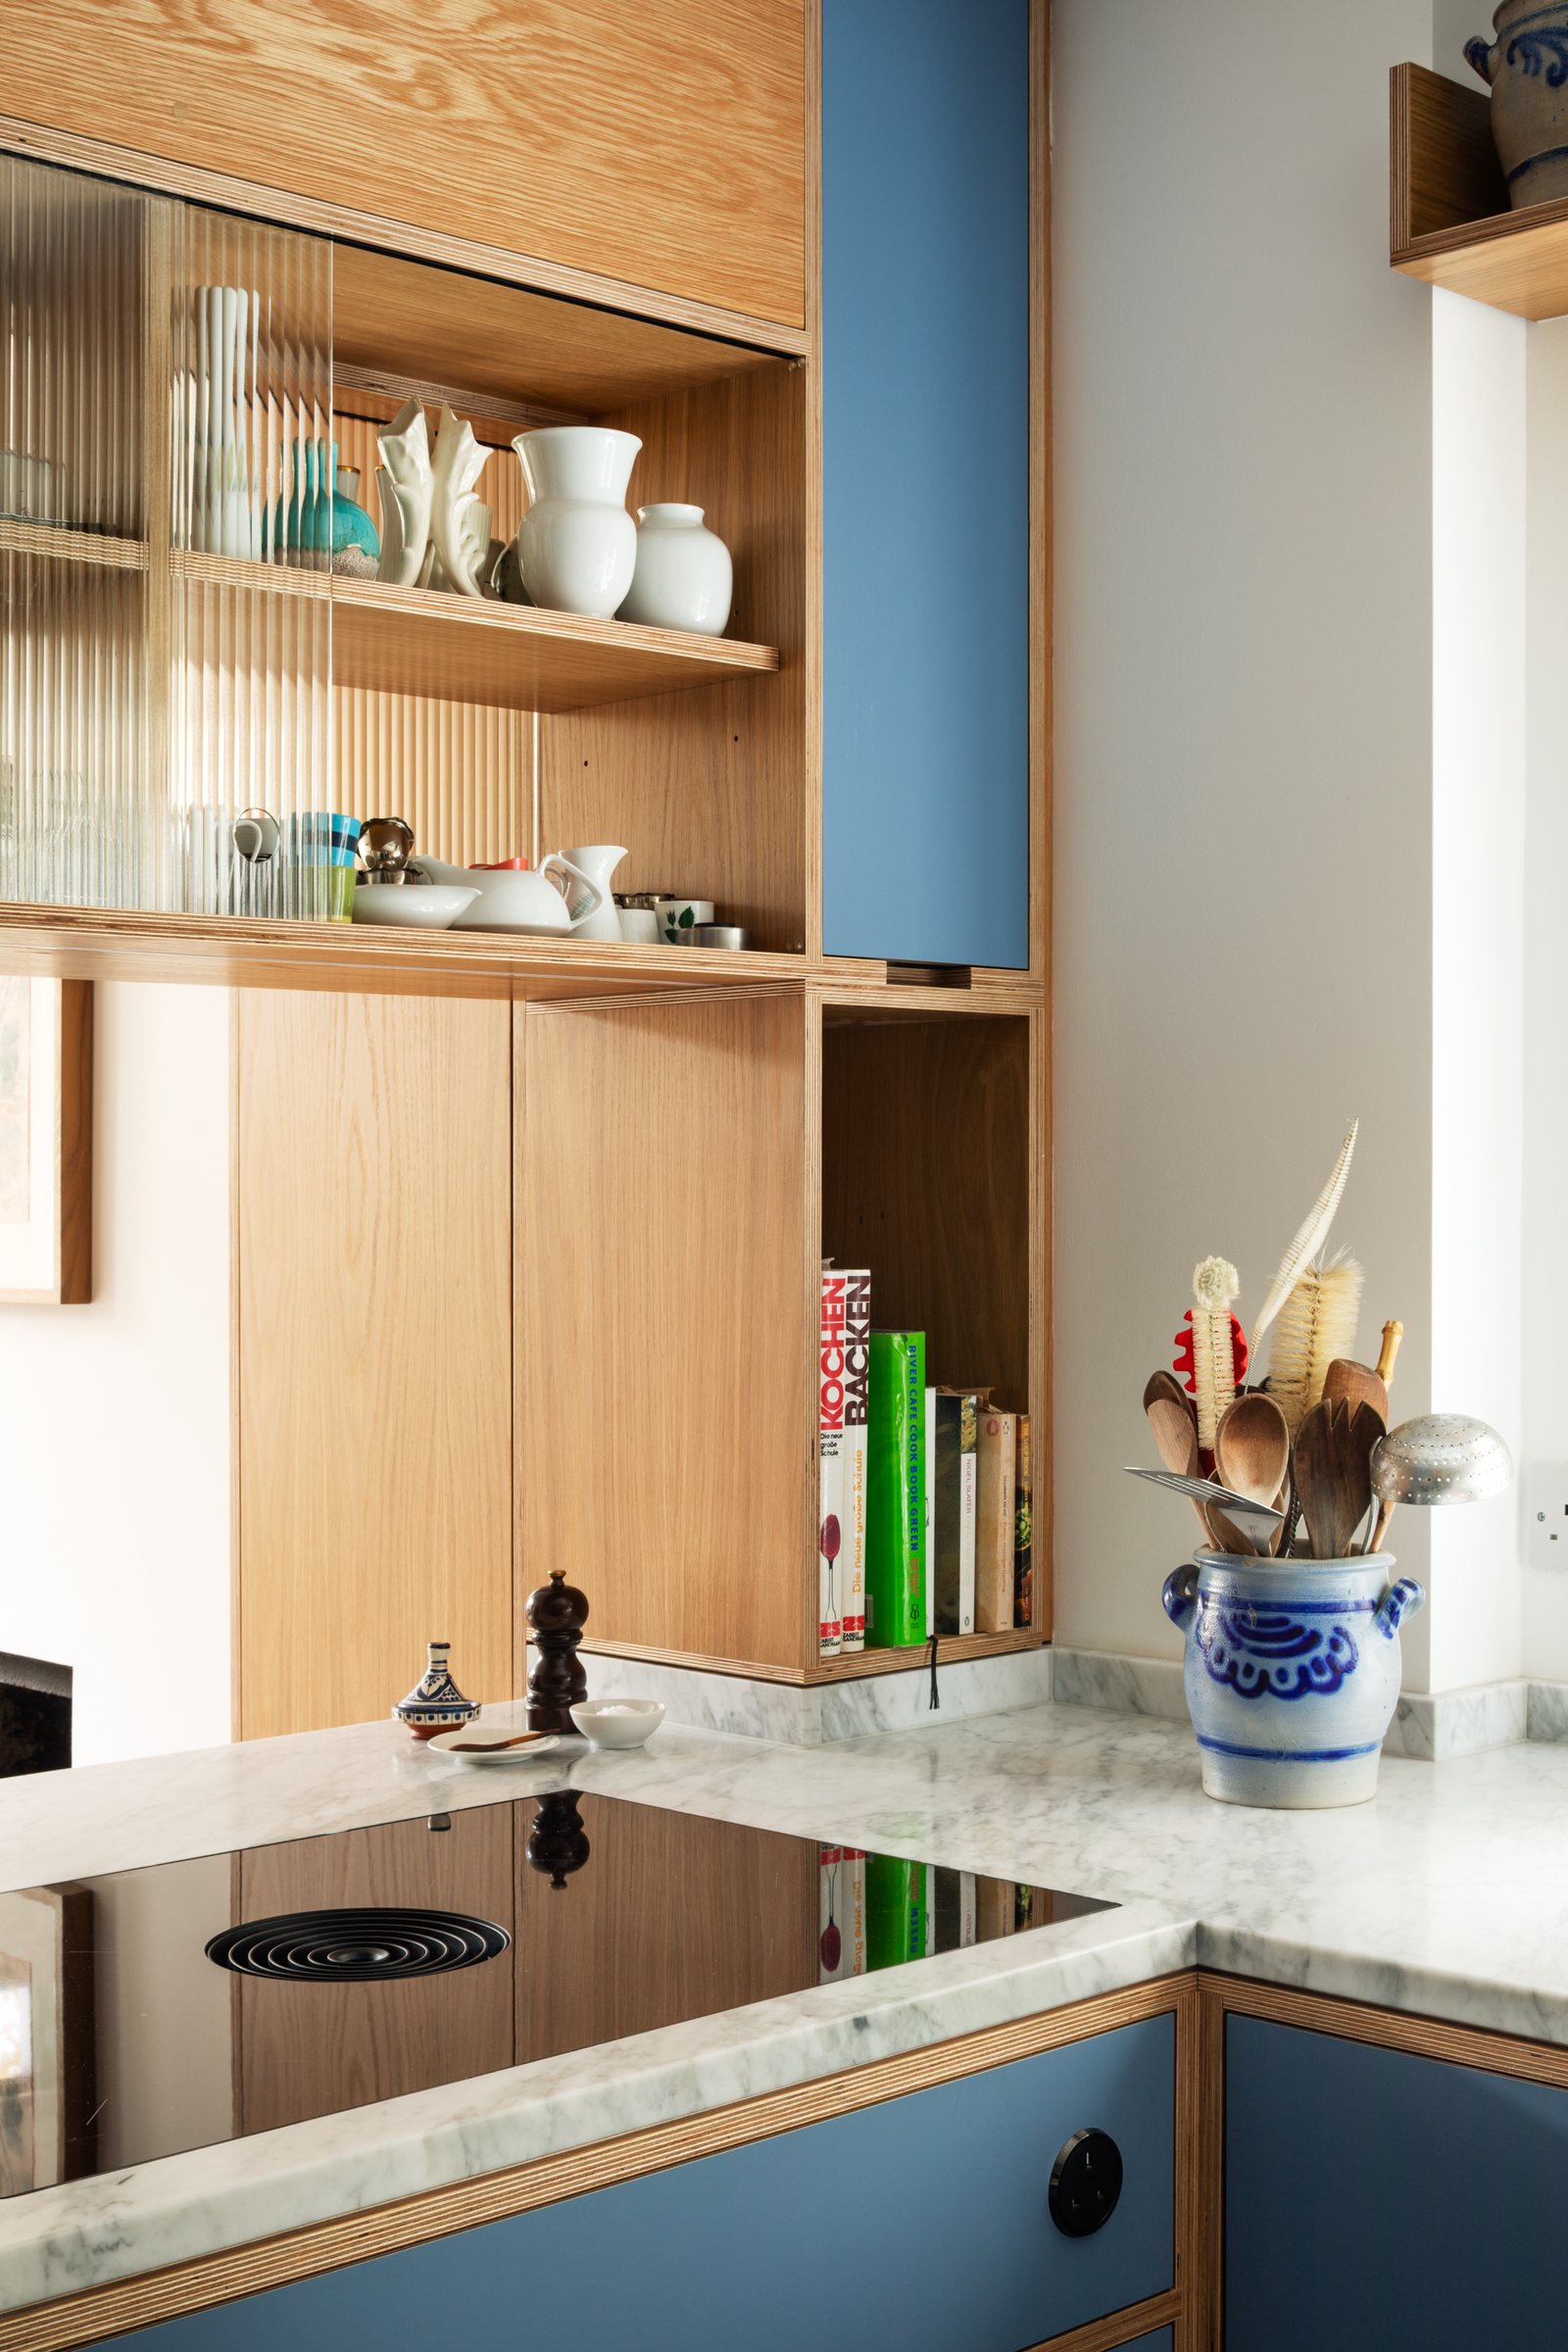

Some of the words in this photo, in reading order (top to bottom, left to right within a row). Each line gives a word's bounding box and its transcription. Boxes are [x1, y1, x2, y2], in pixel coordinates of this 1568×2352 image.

[820, 1277, 846, 1431] KOCHEN
[845, 1275, 871, 1426] BACKEN
[908, 1345, 917, 1385] RIVER
[908, 1389, 918, 1421] CAFE
[820, 1441, 838, 1450] große
[909, 1424, 918, 1462] COOK
[854, 1448, 863, 1492] Schule
[909, 1465, 918, 1504] BOOK
[854, 1495, 863, 1534] große
[909, 1507, 919, 1551] GREEN
[854, 1537, 862, 1567] neue
[853, 1568, 861, 1593] Die
